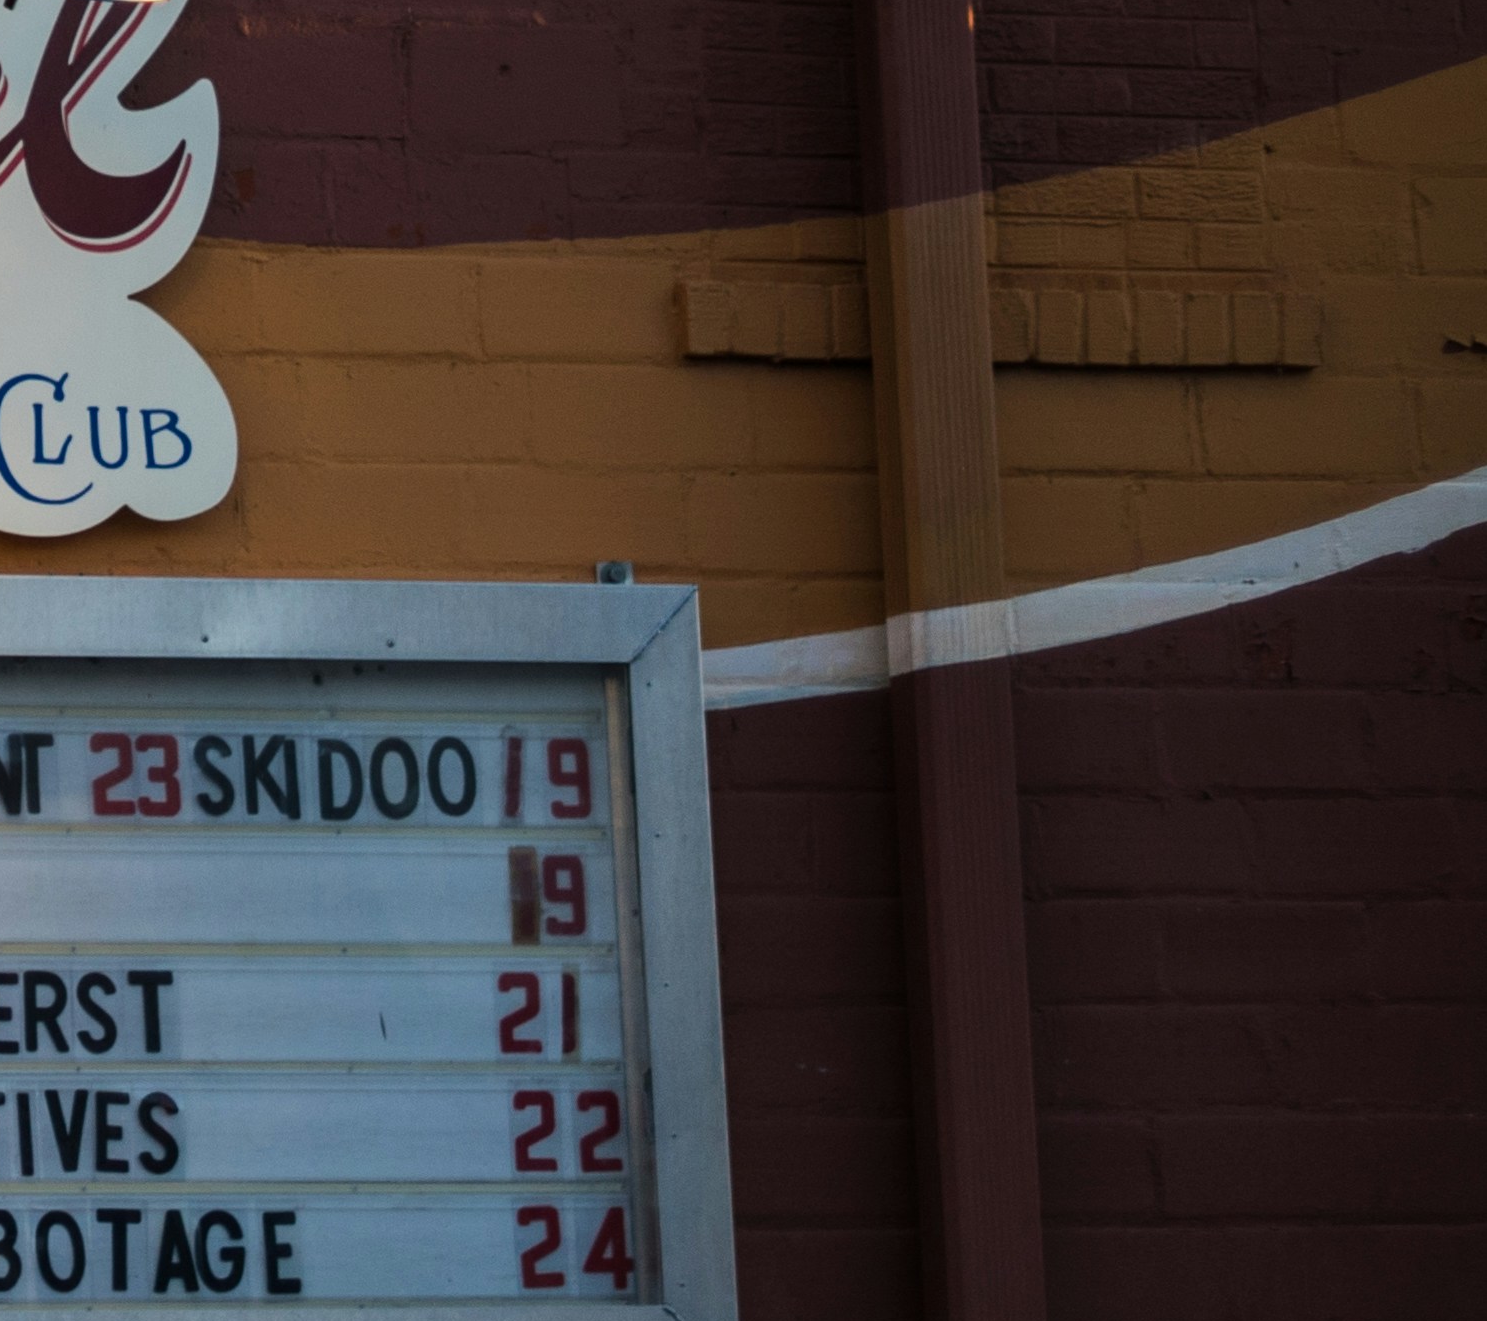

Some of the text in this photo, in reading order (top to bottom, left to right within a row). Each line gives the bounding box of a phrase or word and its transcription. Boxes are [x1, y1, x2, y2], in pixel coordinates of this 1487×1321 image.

[504, 737, 592, 819] 19
[509, 850, 587, 940] 19
[497, 971, 577, 1054] 21
[513, 1089, 624, 1173] 22
[517, 1205, 635, 1291] 24
